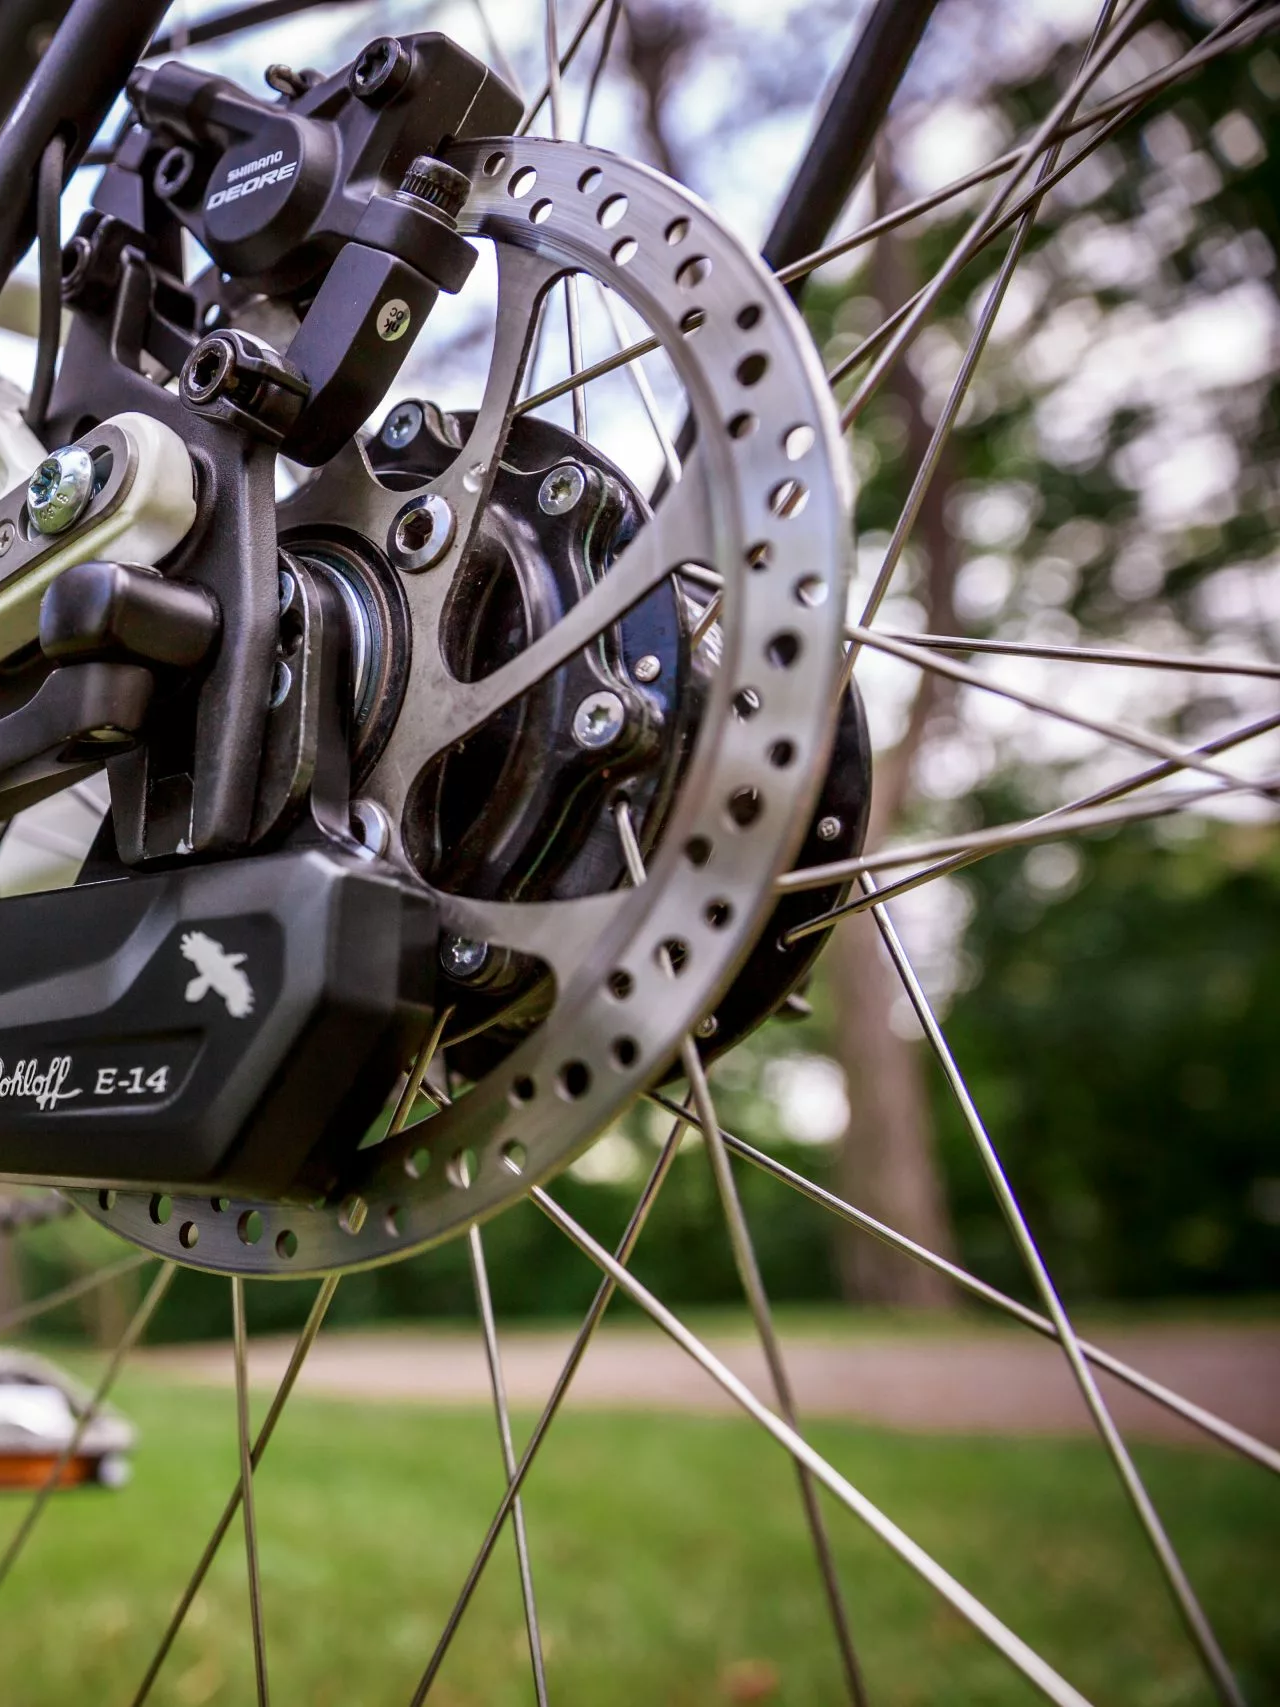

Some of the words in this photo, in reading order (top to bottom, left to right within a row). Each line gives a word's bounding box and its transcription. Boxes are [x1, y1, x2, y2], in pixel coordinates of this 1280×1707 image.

[227, 150, 284, 184] SHIMANO
[206, 161, 298, 210] DEORE
[94, 1066, 169, 1095] E-14
